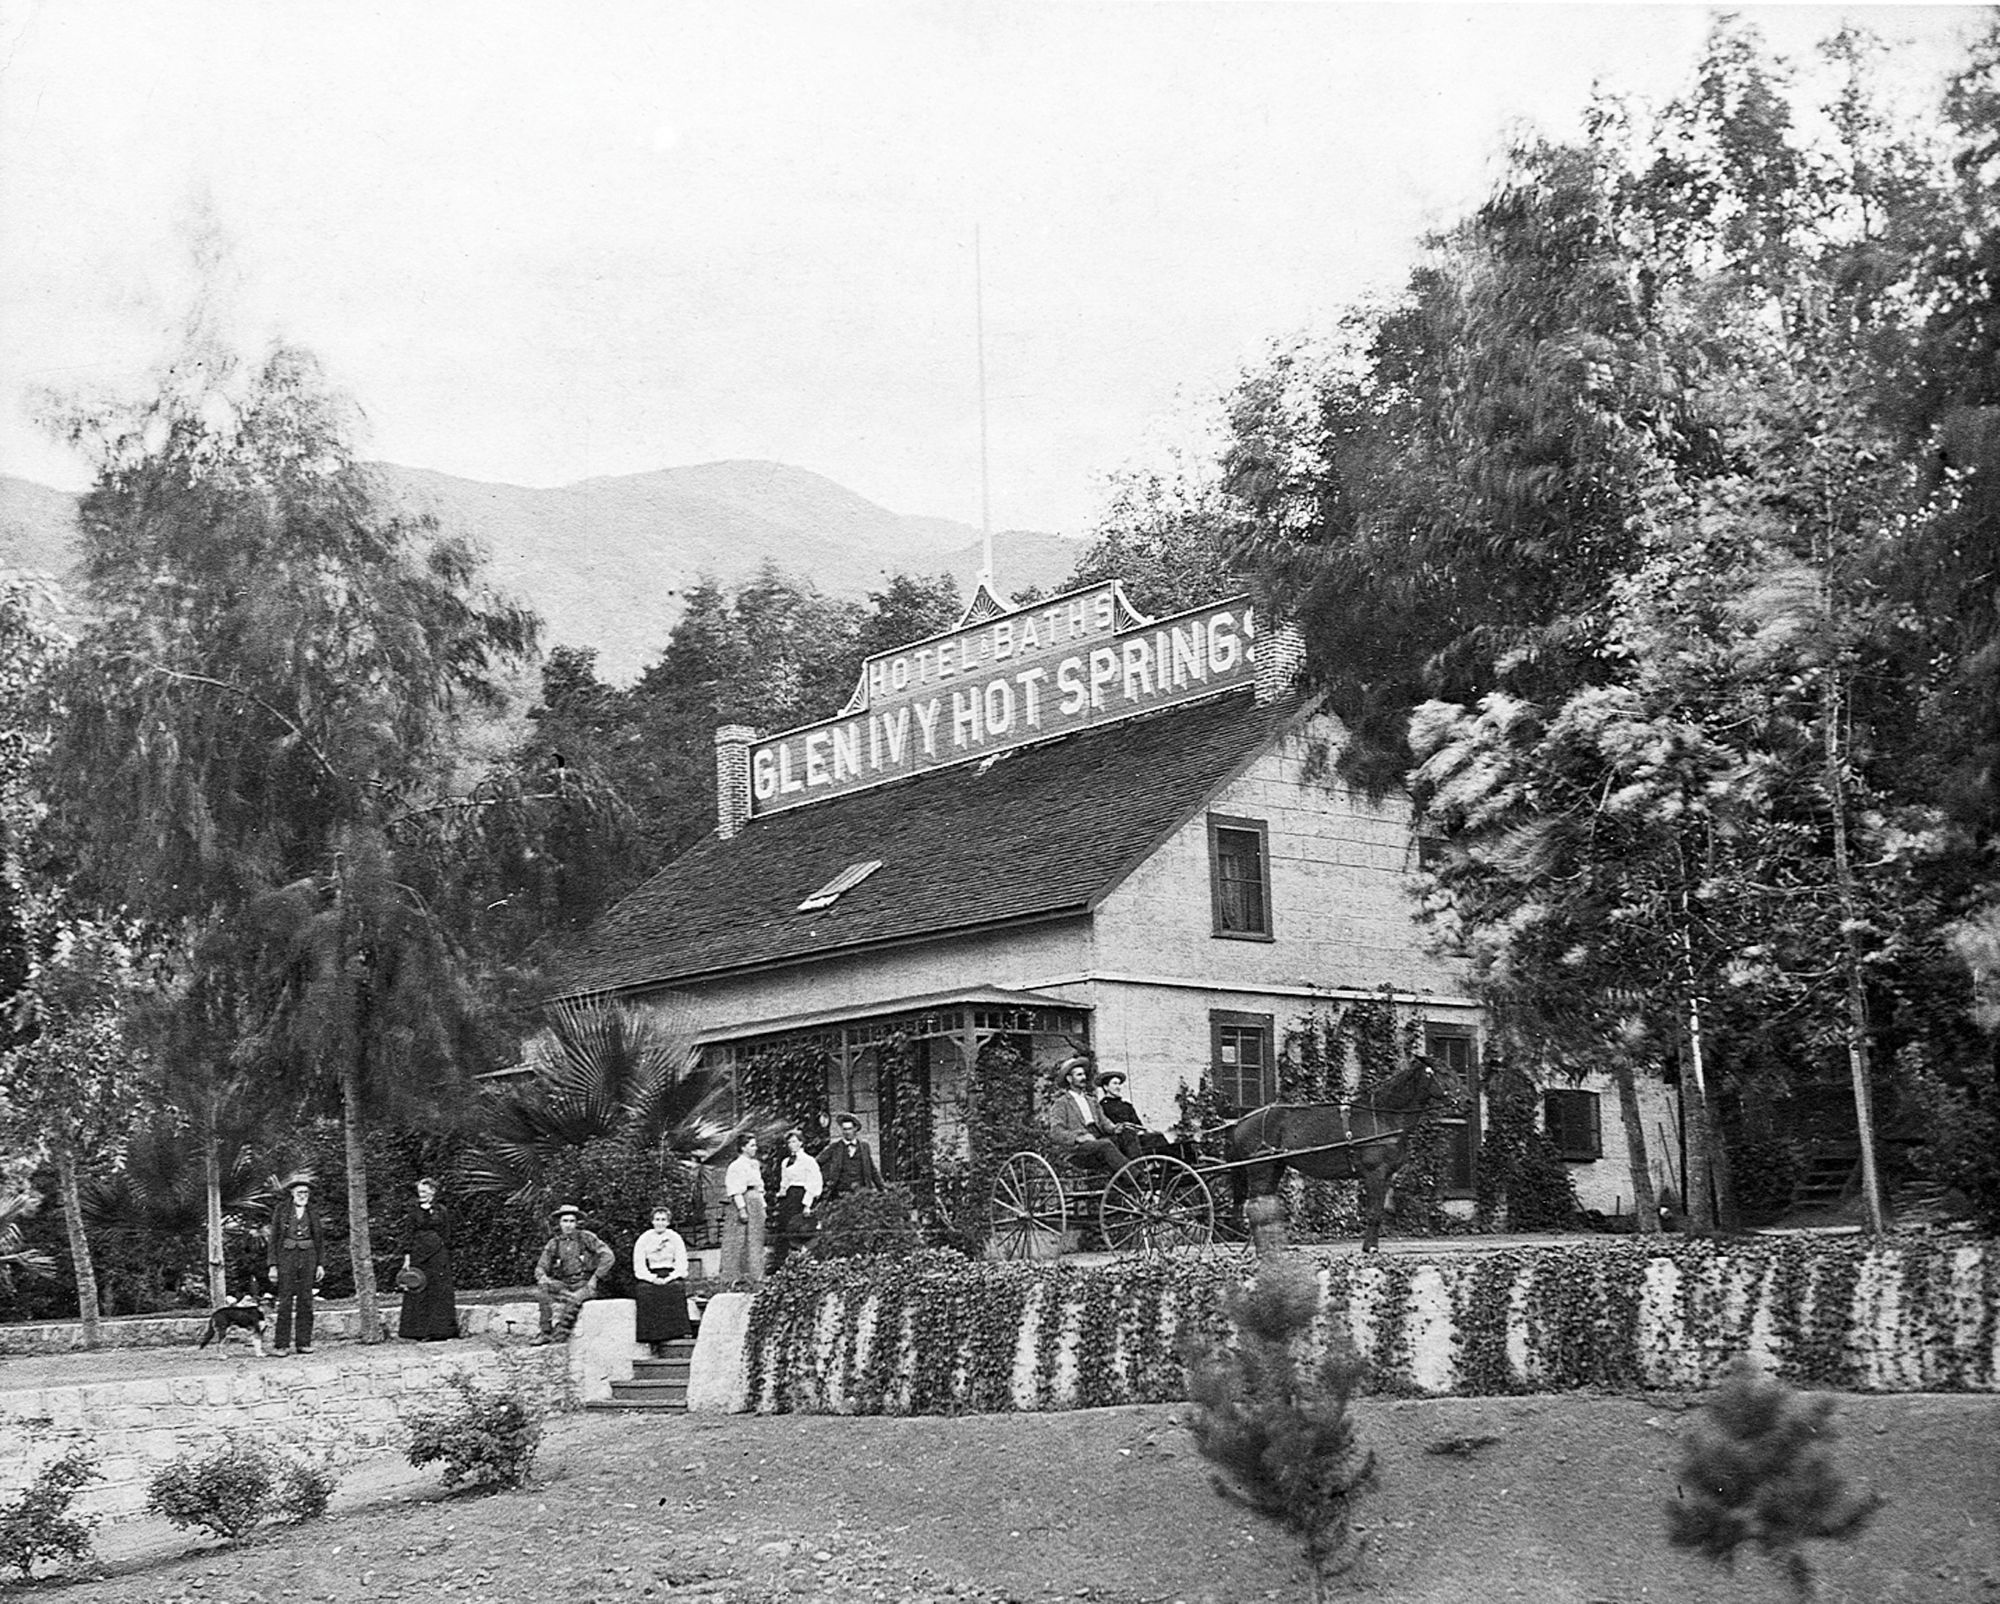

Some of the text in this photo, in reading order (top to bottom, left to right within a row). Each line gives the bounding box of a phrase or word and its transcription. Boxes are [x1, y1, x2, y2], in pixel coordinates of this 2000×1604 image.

[868, 637, 978, 701] HOTEL
[994, 593, 1112, 660] BATHS
[753, 720, 863, 800] GLEN
[869, 697, 942, 773] IVY
[952, 665, 1049, 750] HOT
